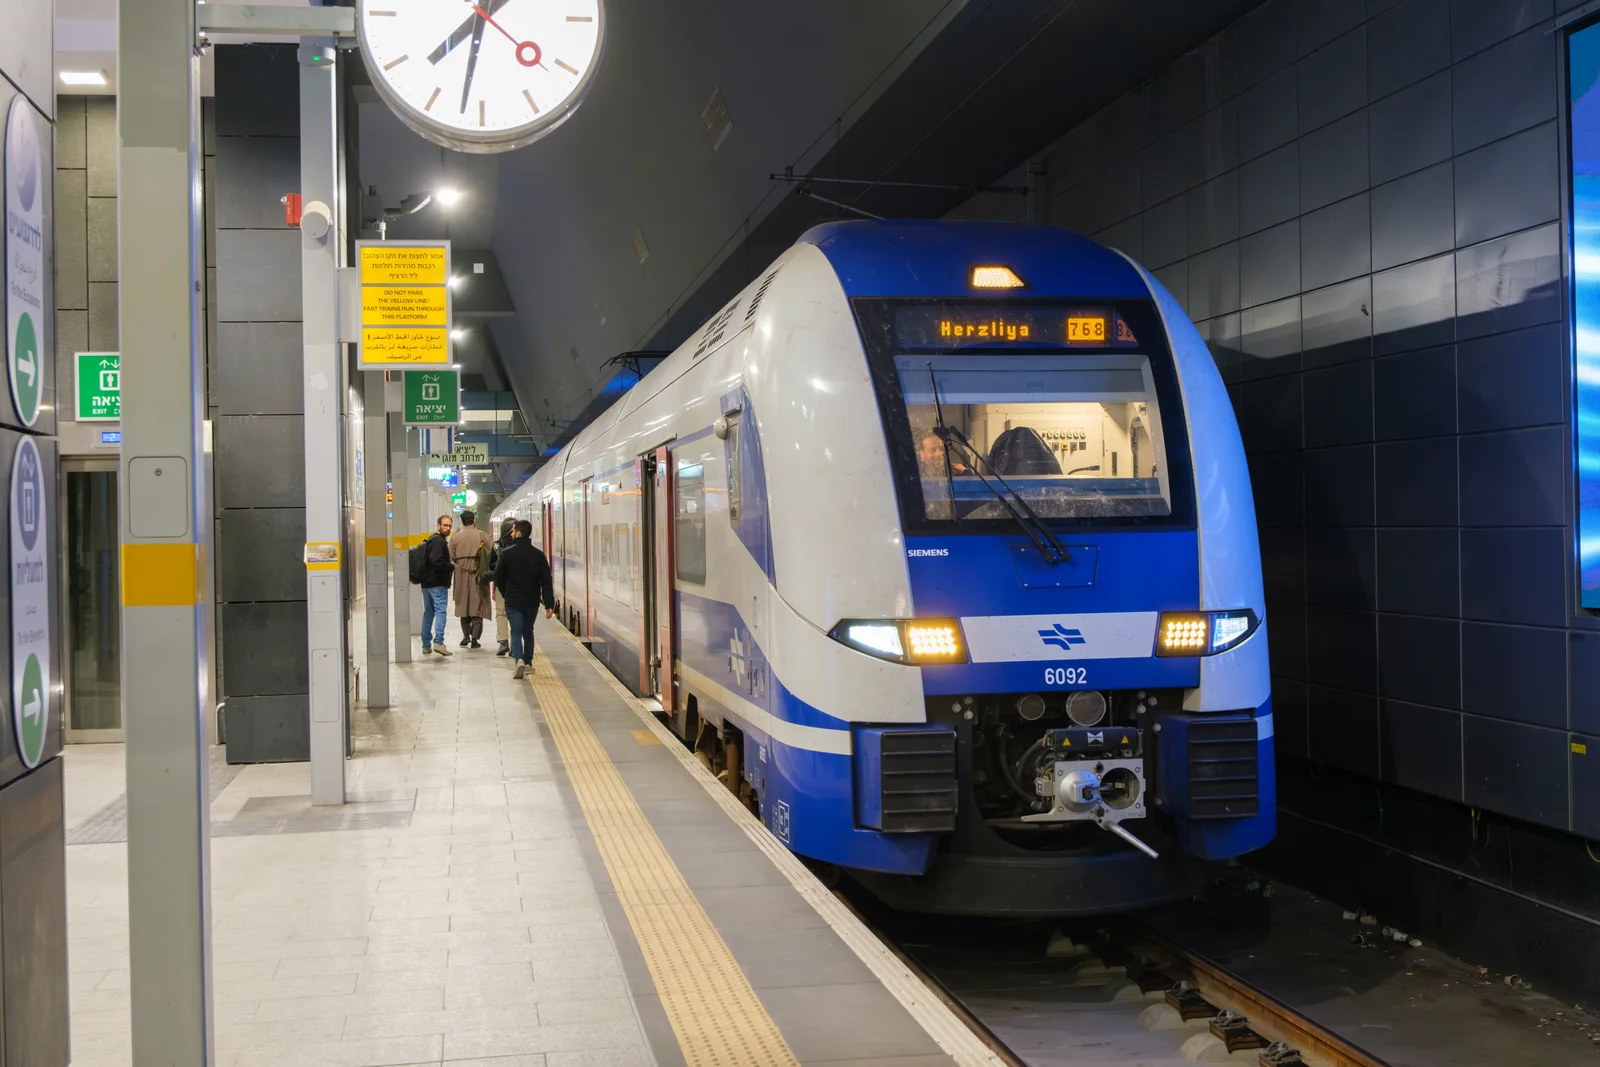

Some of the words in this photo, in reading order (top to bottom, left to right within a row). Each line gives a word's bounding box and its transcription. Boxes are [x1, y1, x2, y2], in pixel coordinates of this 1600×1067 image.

[940, 321, 1029, 340] Herzliya
[1069, 322, 1103, 336] 768
[415, 404, 447, 413] יציאה
[441, 454, 457, 463] מוגן
[460, 454, 485, 463] למרחב
[908, 549, 949, 557] SIEMENS
[1044, 667, 1087, 685] 6092
